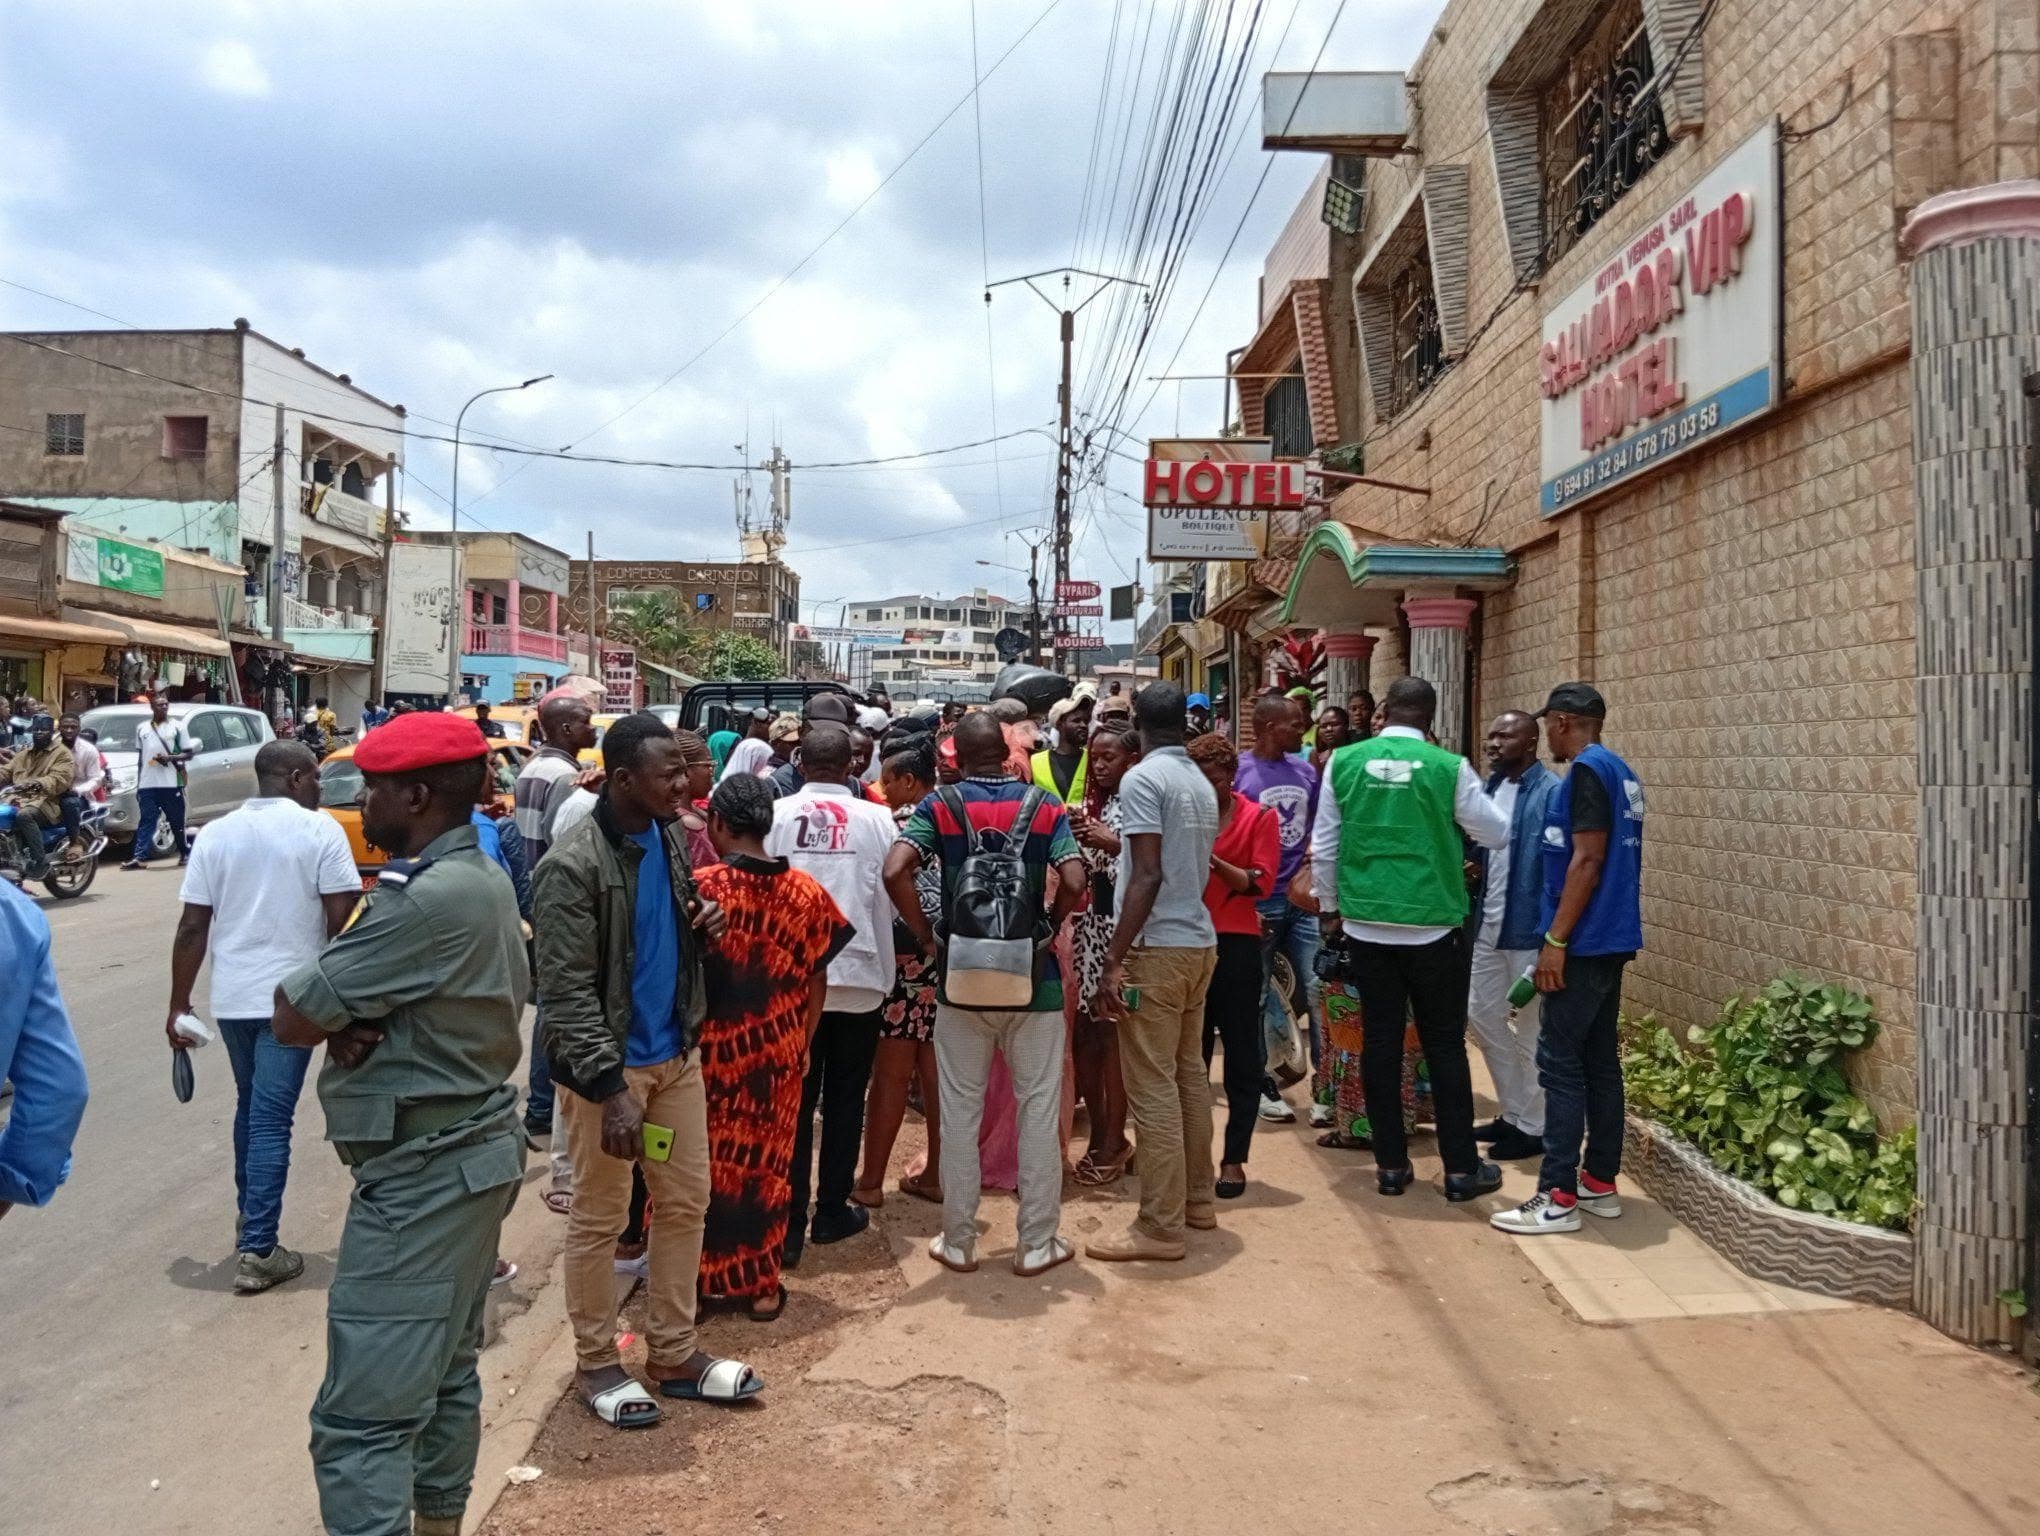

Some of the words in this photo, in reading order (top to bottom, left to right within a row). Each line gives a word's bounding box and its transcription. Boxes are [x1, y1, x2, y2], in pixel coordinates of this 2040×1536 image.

[1669, 197, 1698, 235] SARL
[1539, 247, 1684, 399] SALVADOR
[1685, 192, 1752, 296] VIP
[1580, 338, 1685, 451] HOTEL
[1564, 474, 1581, 497] 694
[1583, 466, 1595, 487] 81
[1598, 457, 1612, 480] 32
[1613, 449, 1628, 474] 84
[1635, 434, 1658, 462] 678
[1660, 424, 1677, 449] 78
[1679, 413, 1697, 439] 03
[1700, 403, 1718, 430] 58
[1146, 461, 1303, 504] HOTEL
[1159, 508, 1261, 521] OPULENCE
[1182, 522, 1235, 531] BOUTIQUE
[608, 567, 673, 580] COMPLEXE
[1059, 585, 1097, 597] BYPARIS
[1056, 606, 1102, 616] RESTAURANT
[1057, 637, 1103, 648] LOUNGE
